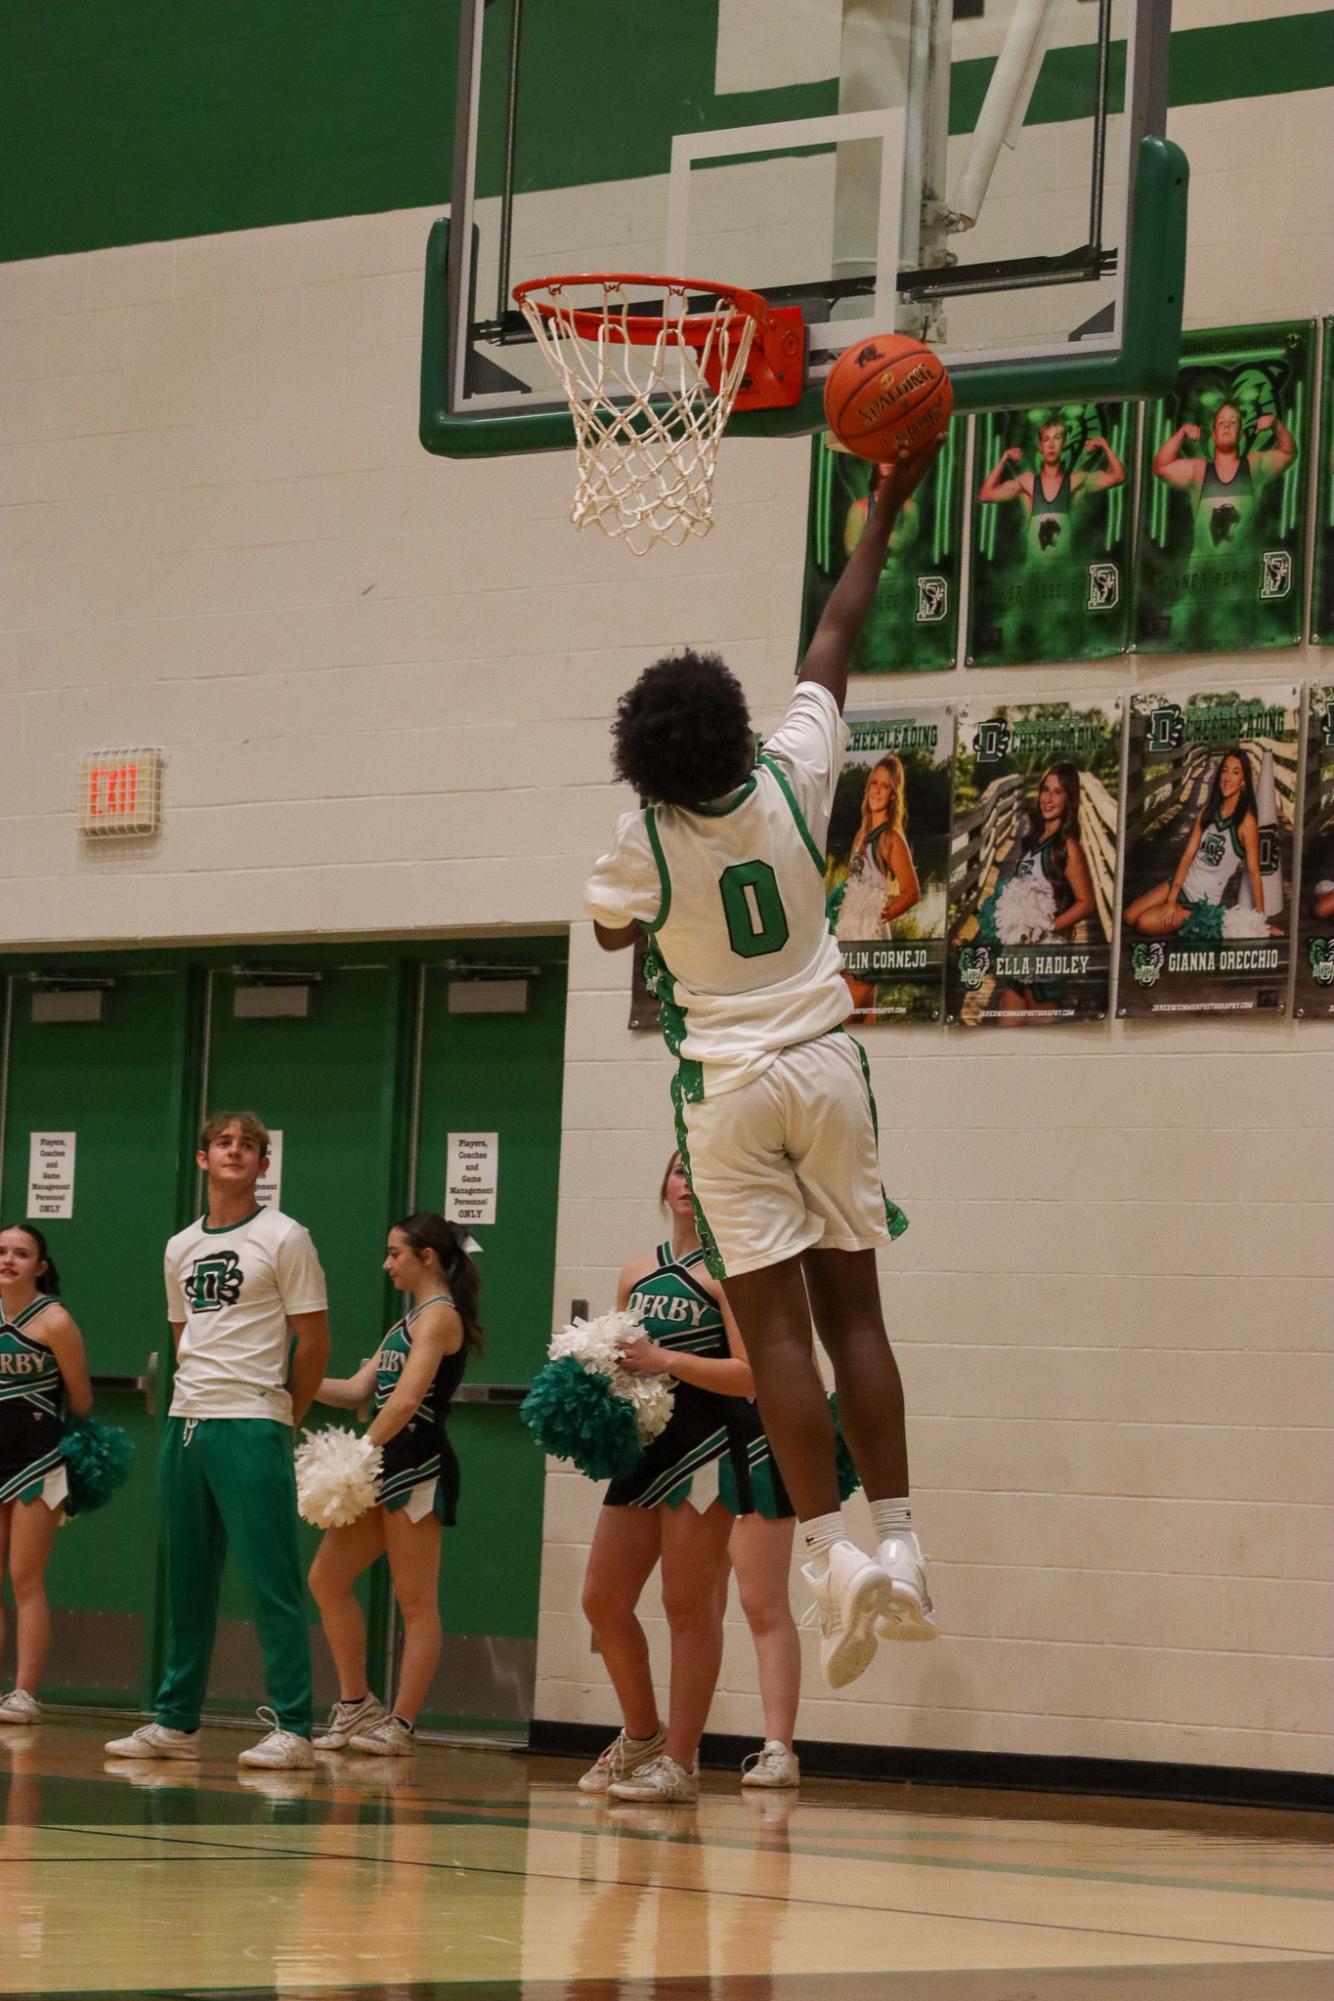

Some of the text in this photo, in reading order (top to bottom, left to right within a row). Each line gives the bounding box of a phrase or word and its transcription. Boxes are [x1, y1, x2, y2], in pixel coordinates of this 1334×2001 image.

[857, 363, 934, 427] SPALDING
[719, 859, 789, 958] 0
[873, 950, 927, 969] CORNEJO
[1168, 949, 1279, 972] GIANNA ORECCHIO
[996, 955, 1090, 976] ELLA HADLEY
[40, 1138, 67, 1147] Players,
[458, 1139, 488, 1148] Players,
[465, 1163, 479, 1171] and
[31, 1183, 70, 1191] Management
[449, 1187, 493, 1195] Management
[39, 1205, 61, 1213] ONLY
[458, 1210, 483, 1218] ONLY
[629, 1292, 710, 1327] DERBY
